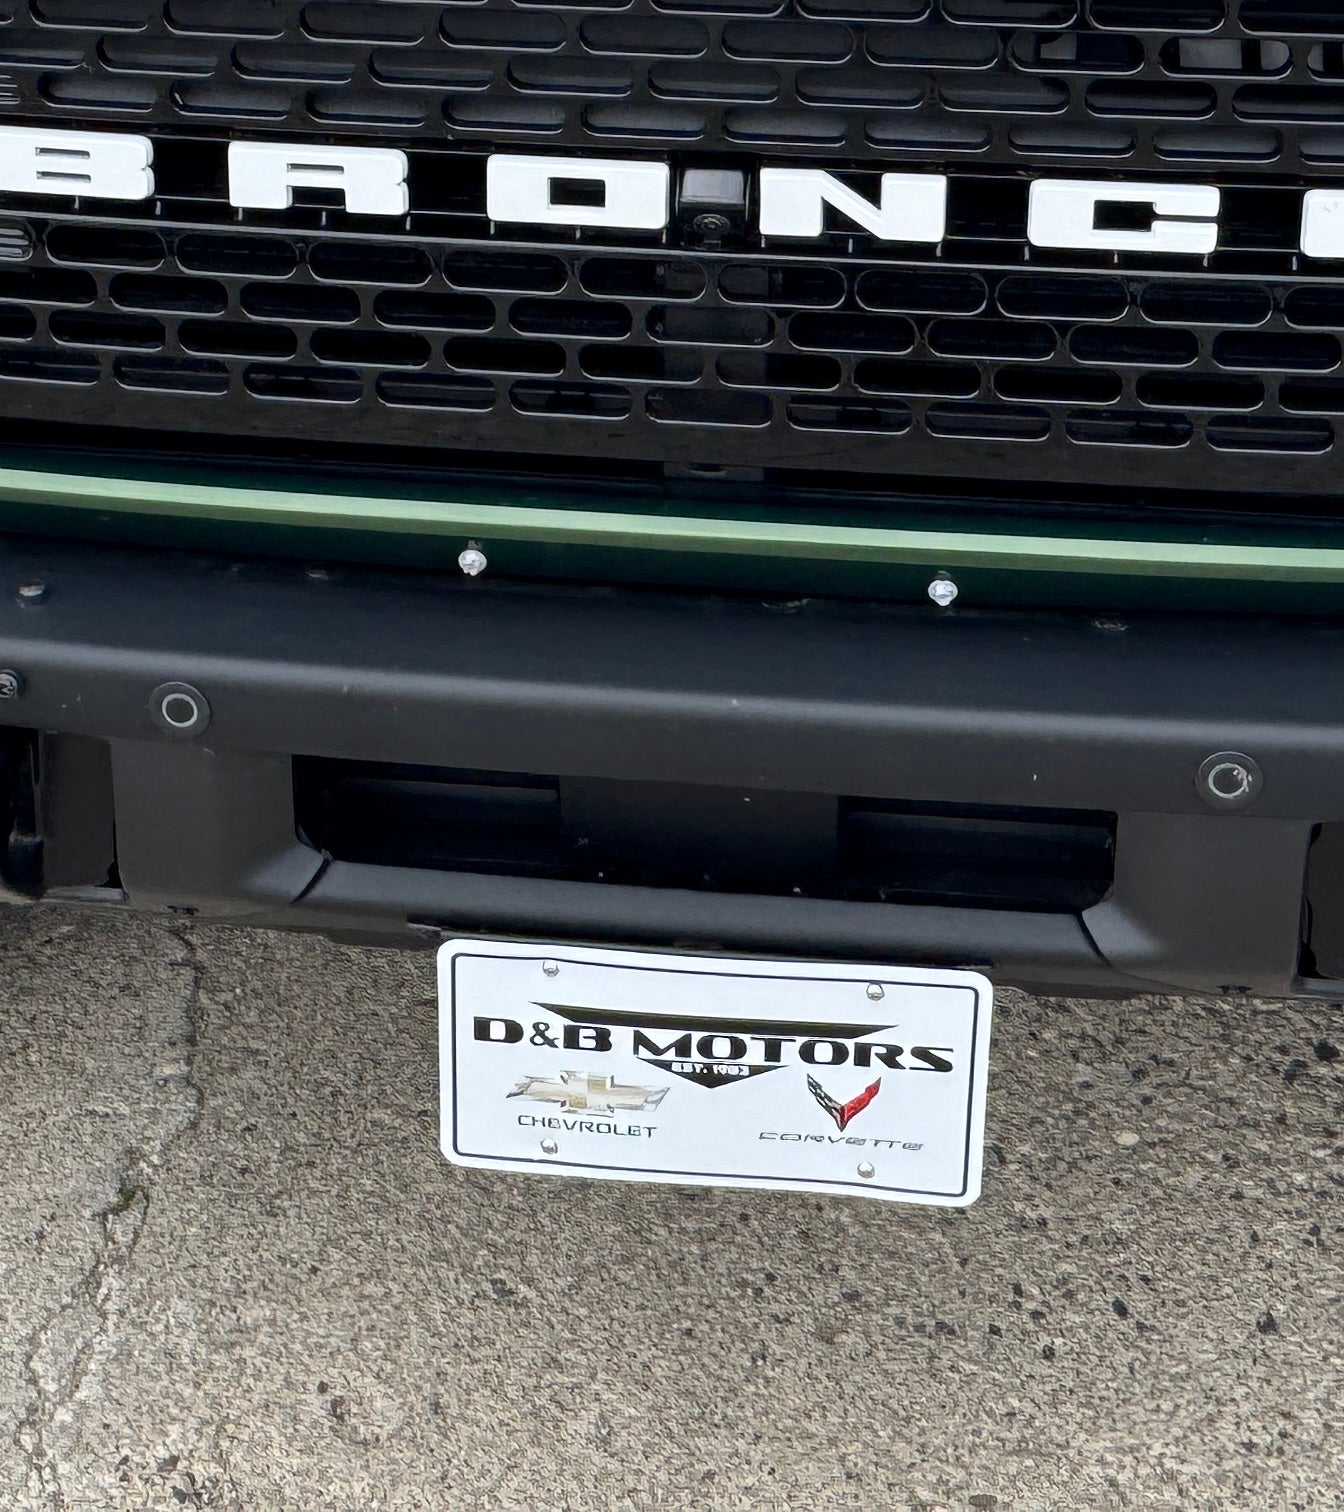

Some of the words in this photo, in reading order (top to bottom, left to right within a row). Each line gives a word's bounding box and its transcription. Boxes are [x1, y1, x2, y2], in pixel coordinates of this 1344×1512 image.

[473, 1016, 613, 1053] D&B
[632, 1029, 954, 1073] MOTORS
[517, 1114, 659, 1139] CHEVROLET
[758, 1131, 925, 1151] CORVETTE
